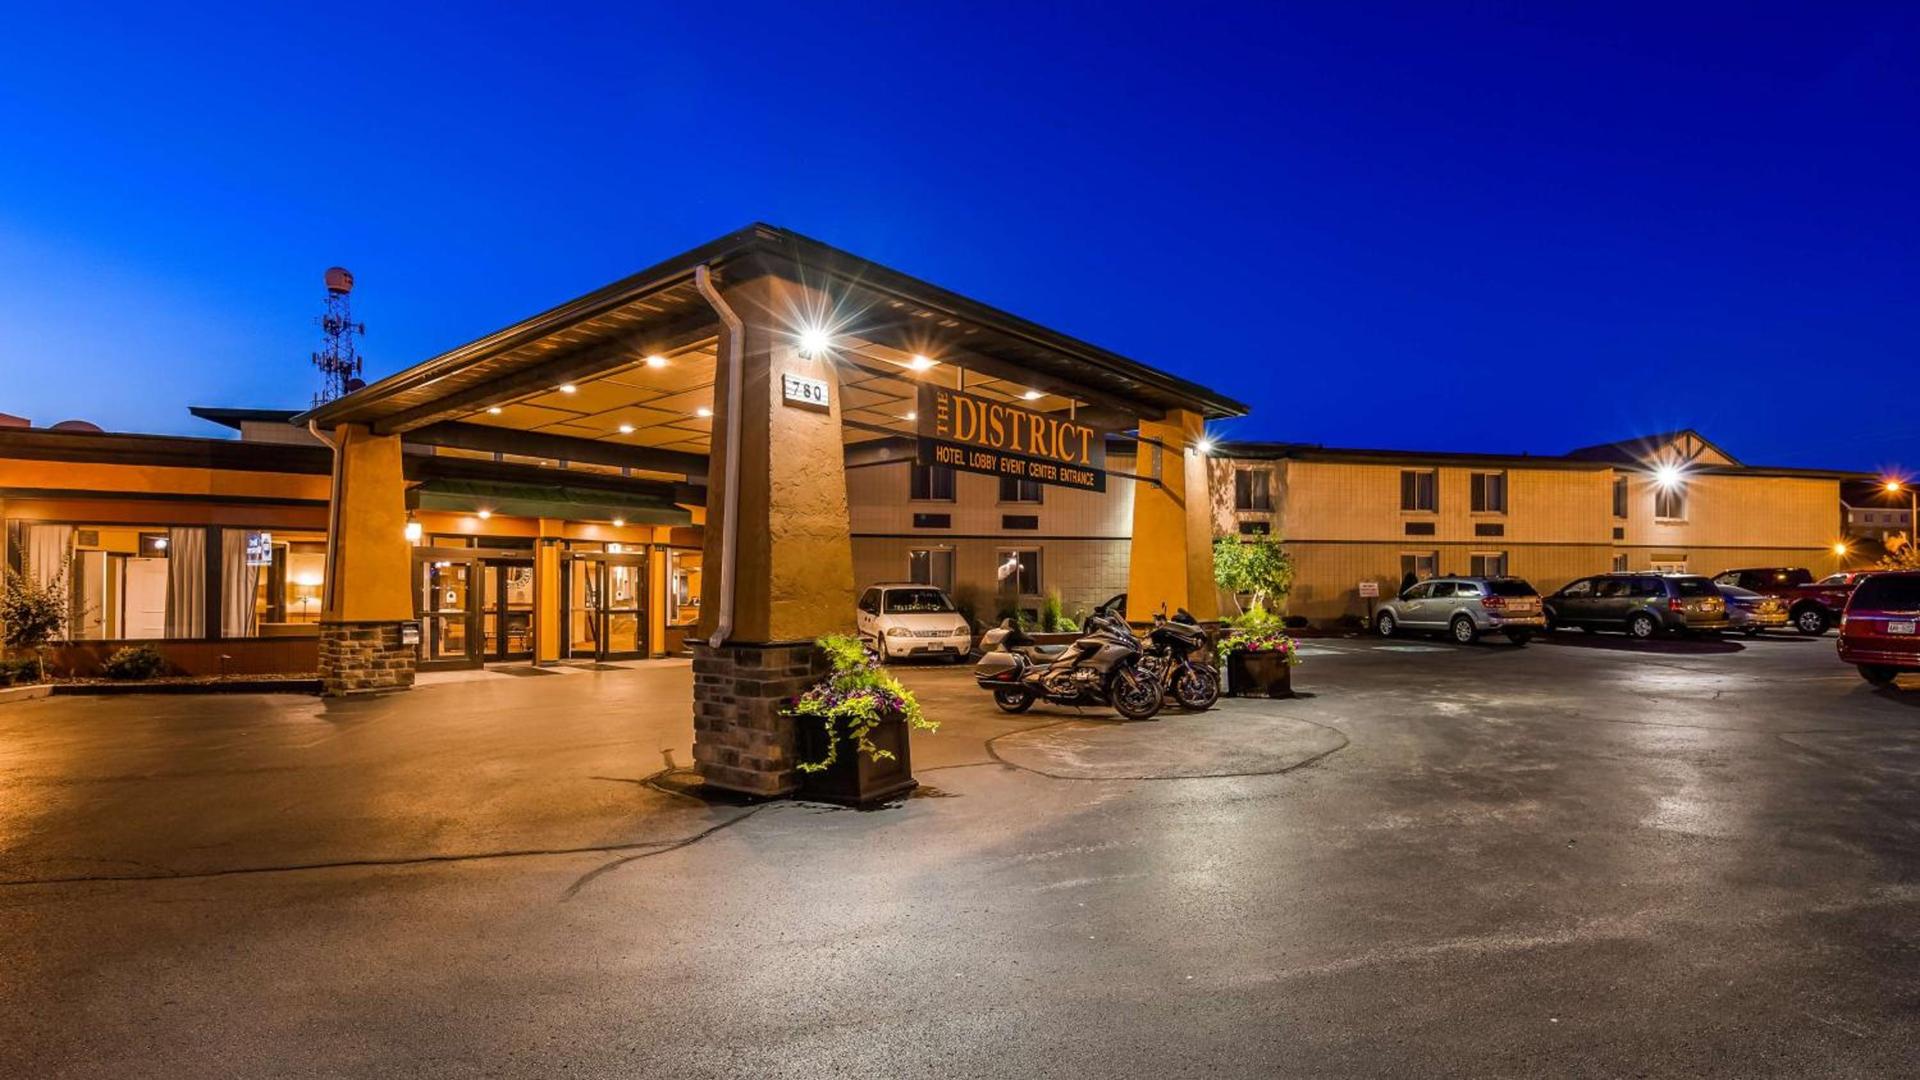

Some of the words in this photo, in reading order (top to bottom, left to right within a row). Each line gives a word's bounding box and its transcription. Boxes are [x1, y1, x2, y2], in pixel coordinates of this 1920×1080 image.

[792, 381, 822, 401] 780
[936, 391, 949, 436] THE
[952, 395, 1094, 465] DISTRICT
[936, 445, 966, 466] HOTEL
[969, 451, 997, 471] LOBBY
[1000, 457, 1026, 475] EVENT
[1028, 462, 1057, 480] CENTER
[1060, 468, 1095, 486] ENTRANCE
